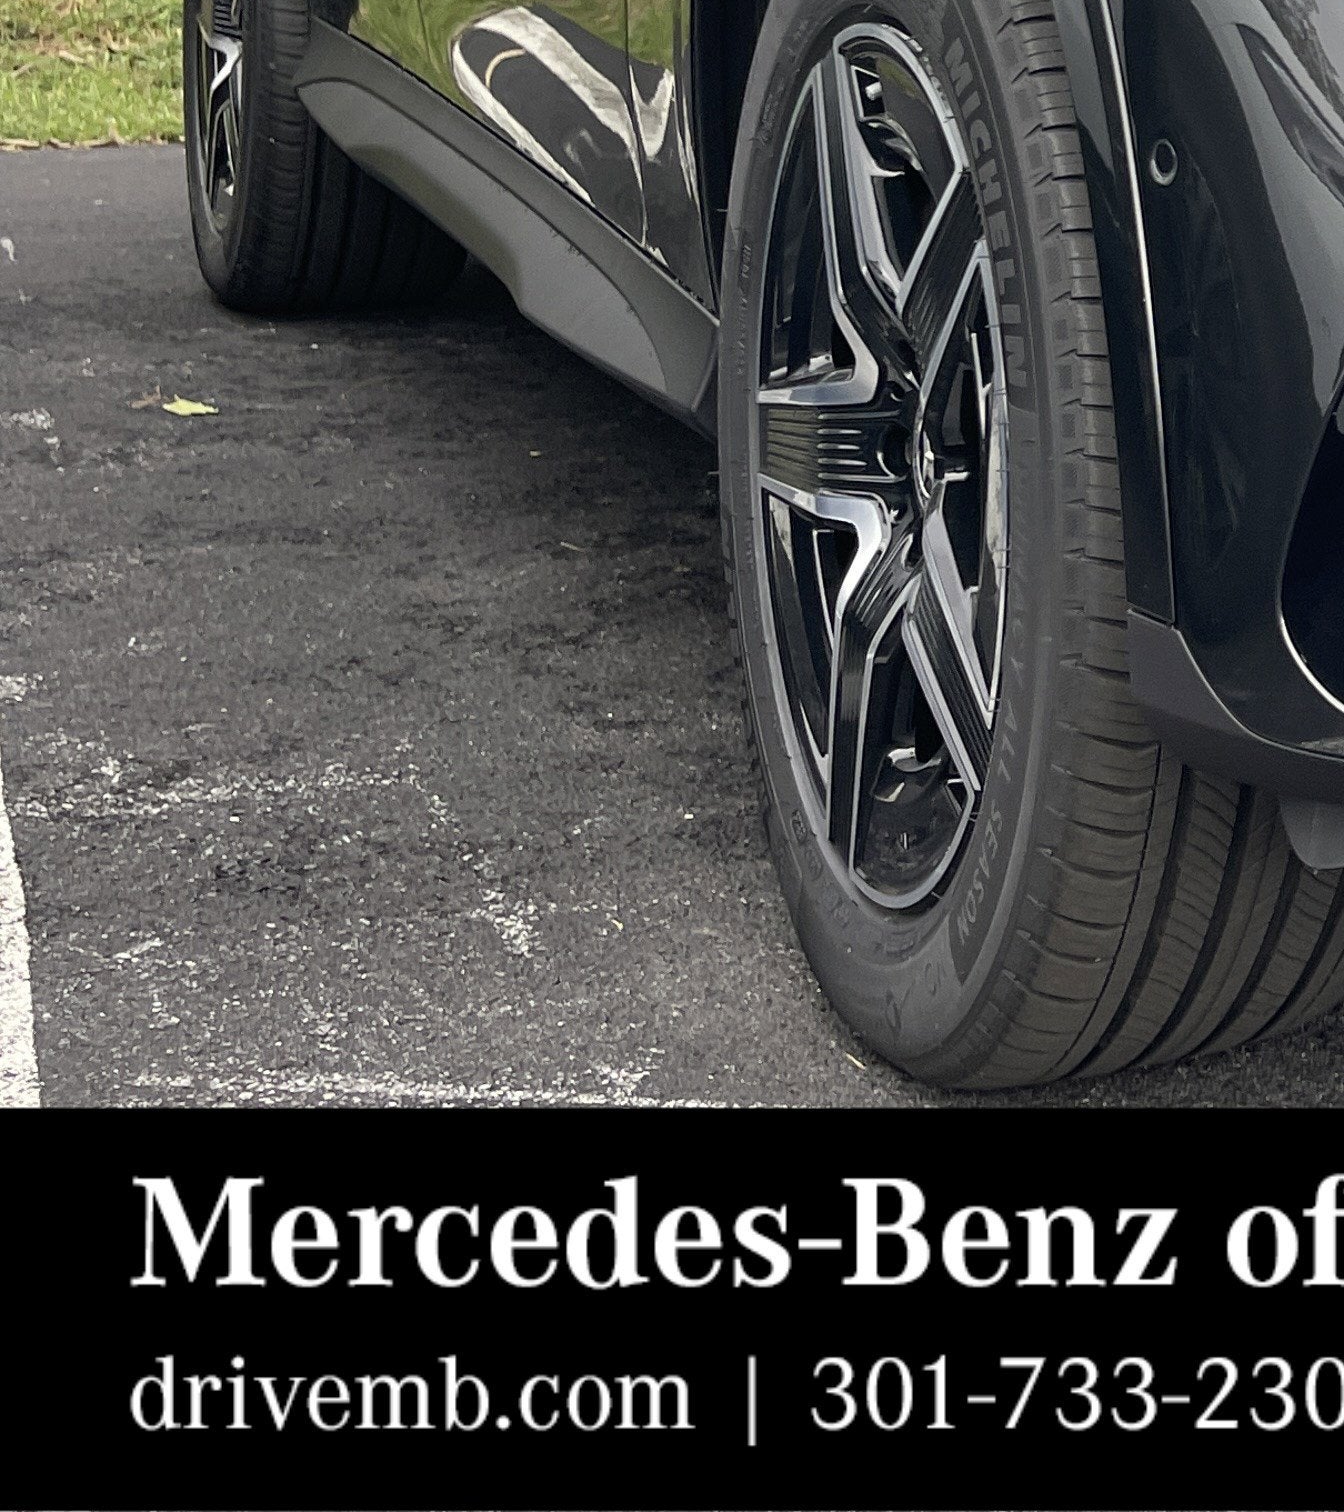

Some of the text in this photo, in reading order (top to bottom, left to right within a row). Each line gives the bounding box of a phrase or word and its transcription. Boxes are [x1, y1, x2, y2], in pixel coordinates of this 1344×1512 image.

[944, 36, 1027, 388] MICHELIN
[998, 697, 1018, 783] ALL
[957, 799, 1002, 947] SEASON
